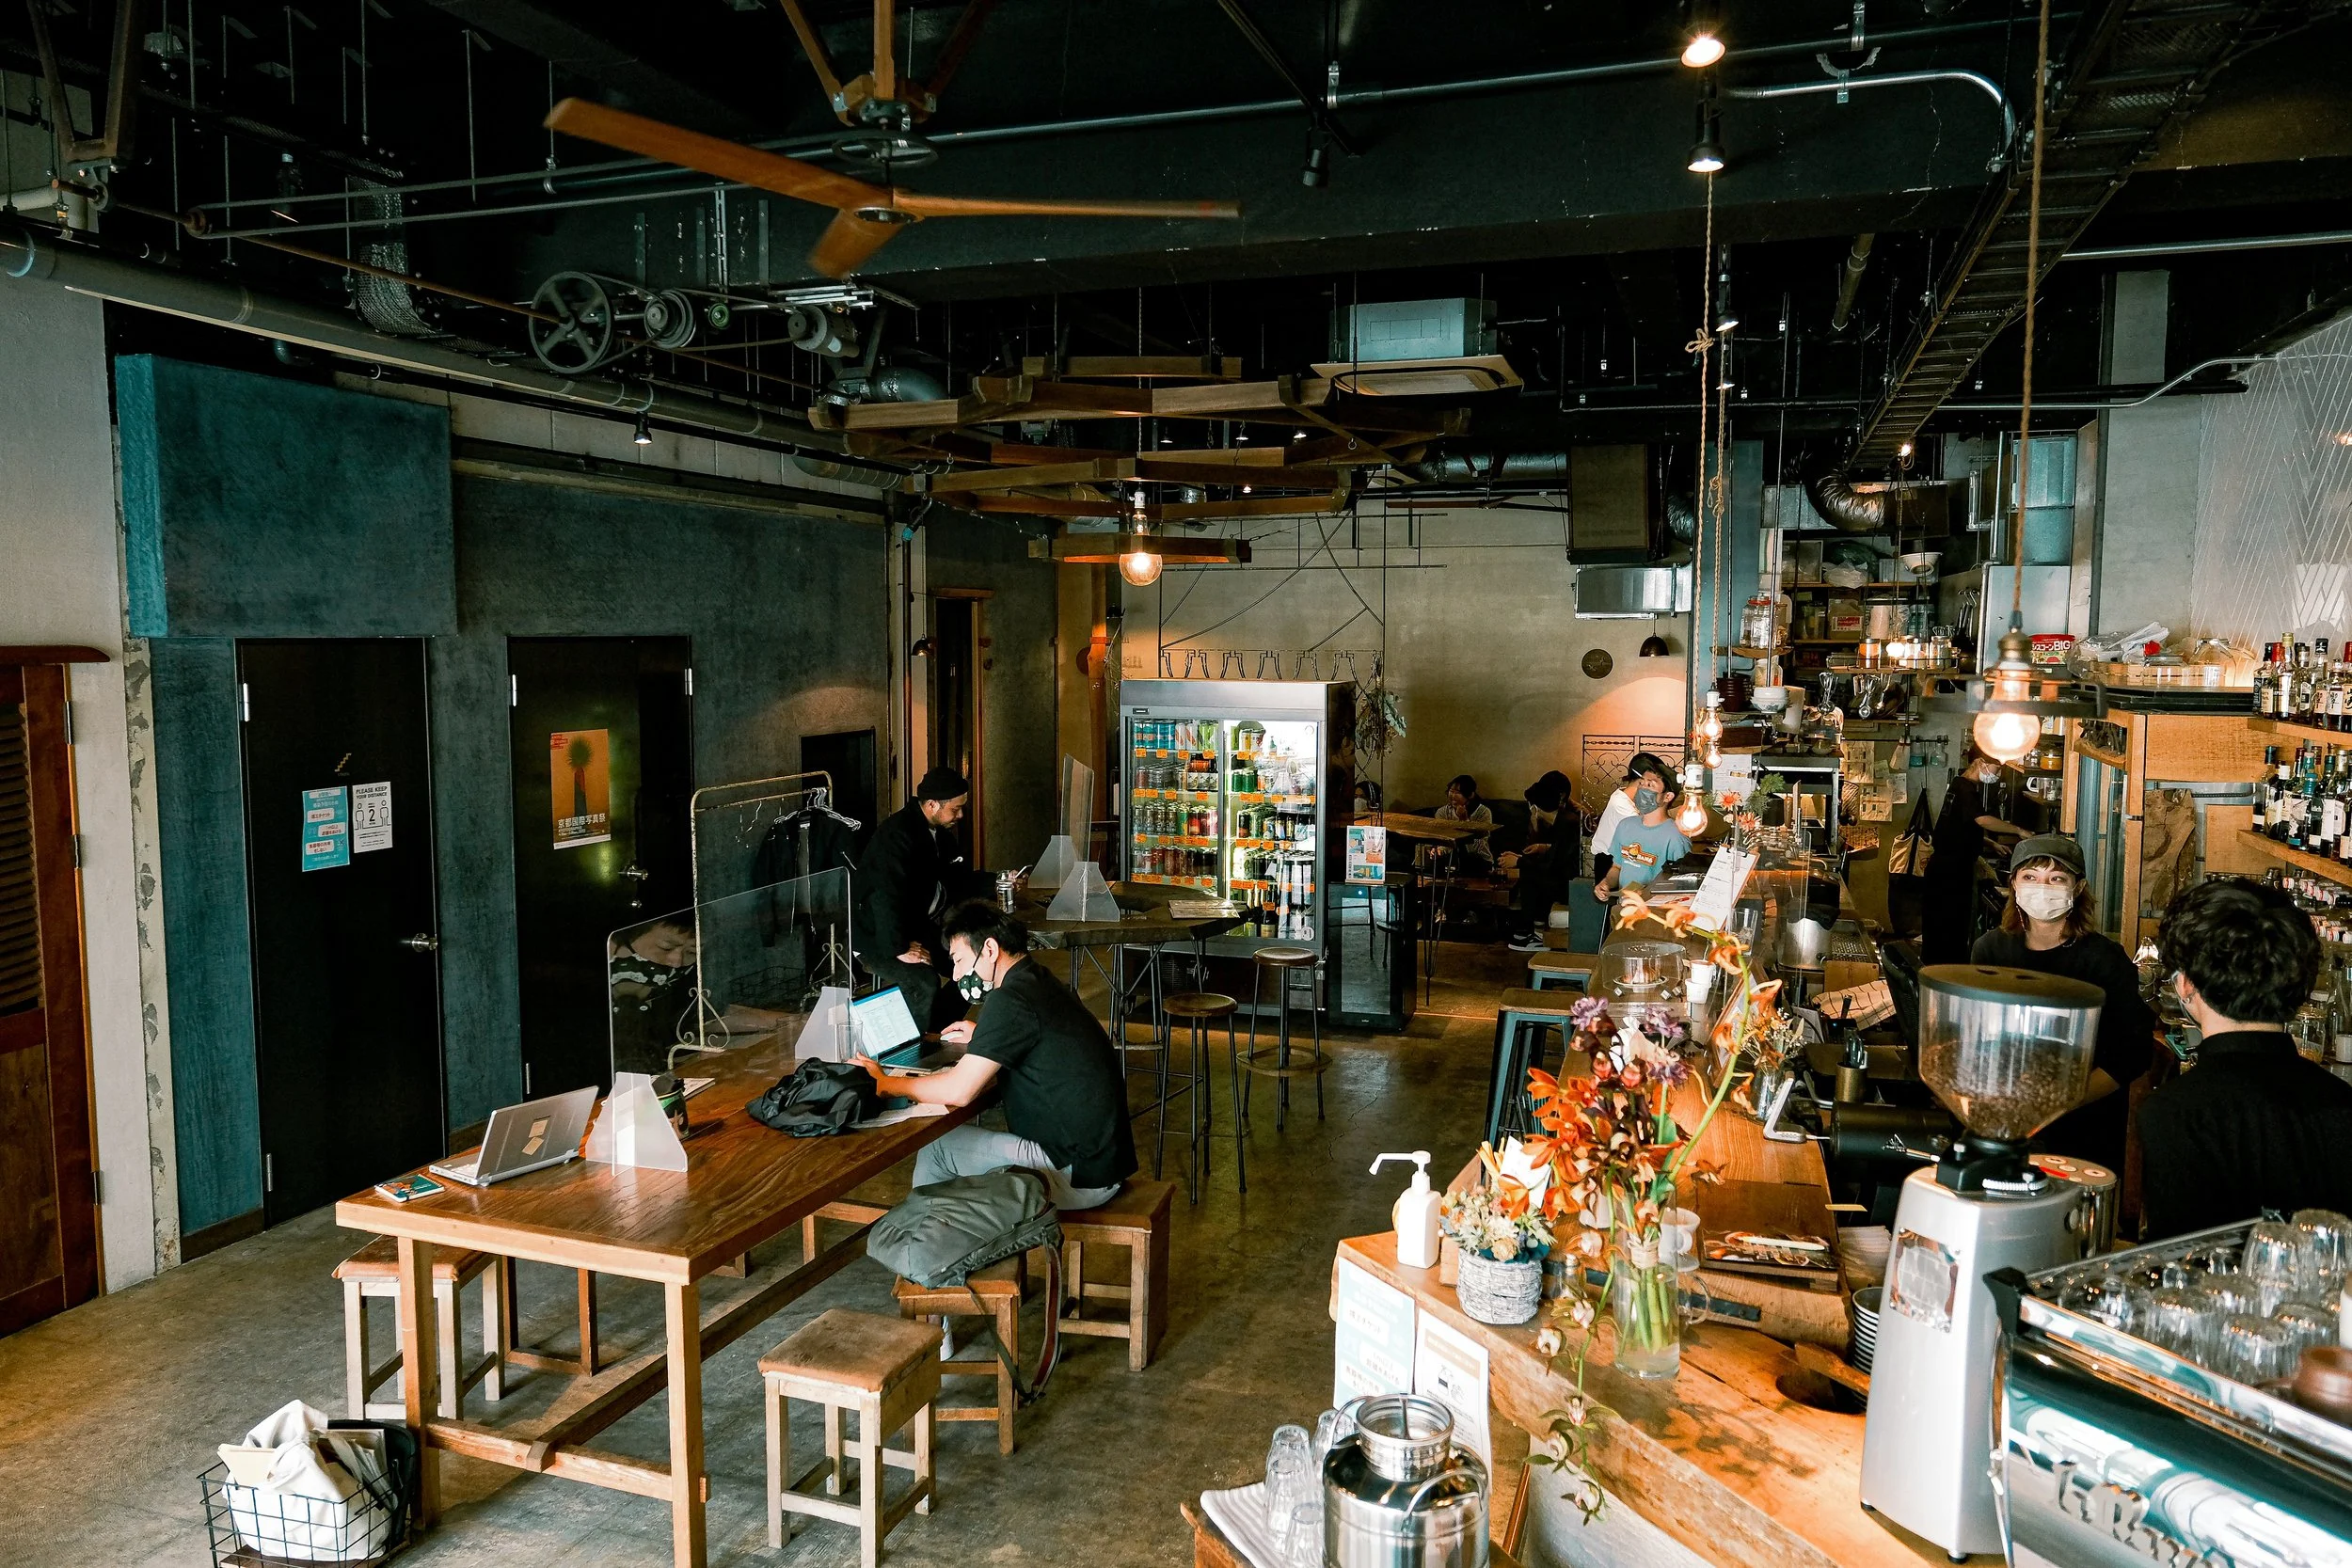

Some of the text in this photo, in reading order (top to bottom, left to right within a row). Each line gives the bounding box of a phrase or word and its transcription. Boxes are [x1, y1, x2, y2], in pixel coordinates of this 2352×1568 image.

[368, 808, 375, 822] 2
[557, 813, 606, 829] 京都国際写真祭
